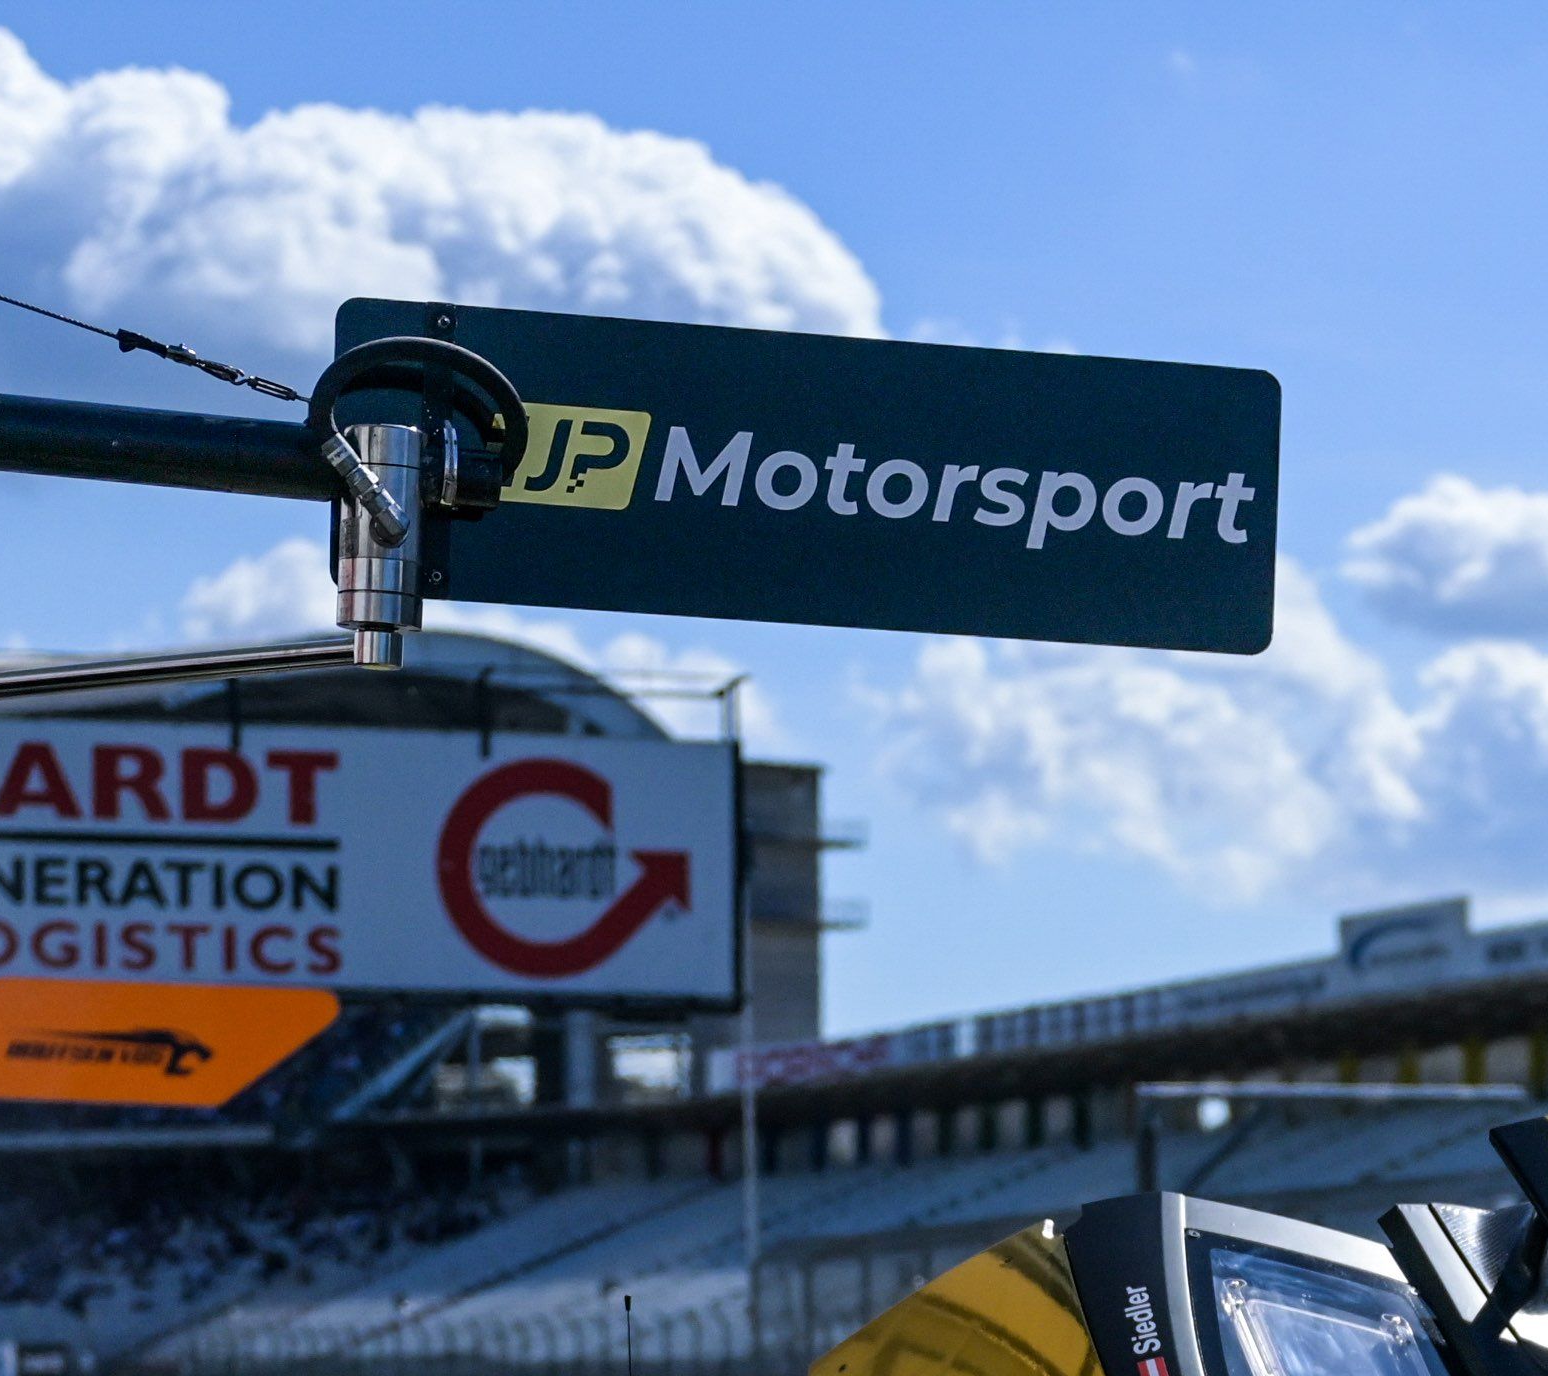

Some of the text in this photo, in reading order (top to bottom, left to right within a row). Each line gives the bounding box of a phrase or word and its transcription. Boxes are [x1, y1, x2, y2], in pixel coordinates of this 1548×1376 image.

[524, 418, 1255, 549] JP Motorsport
[1126, 1286, 1161, 1356] Siedler
